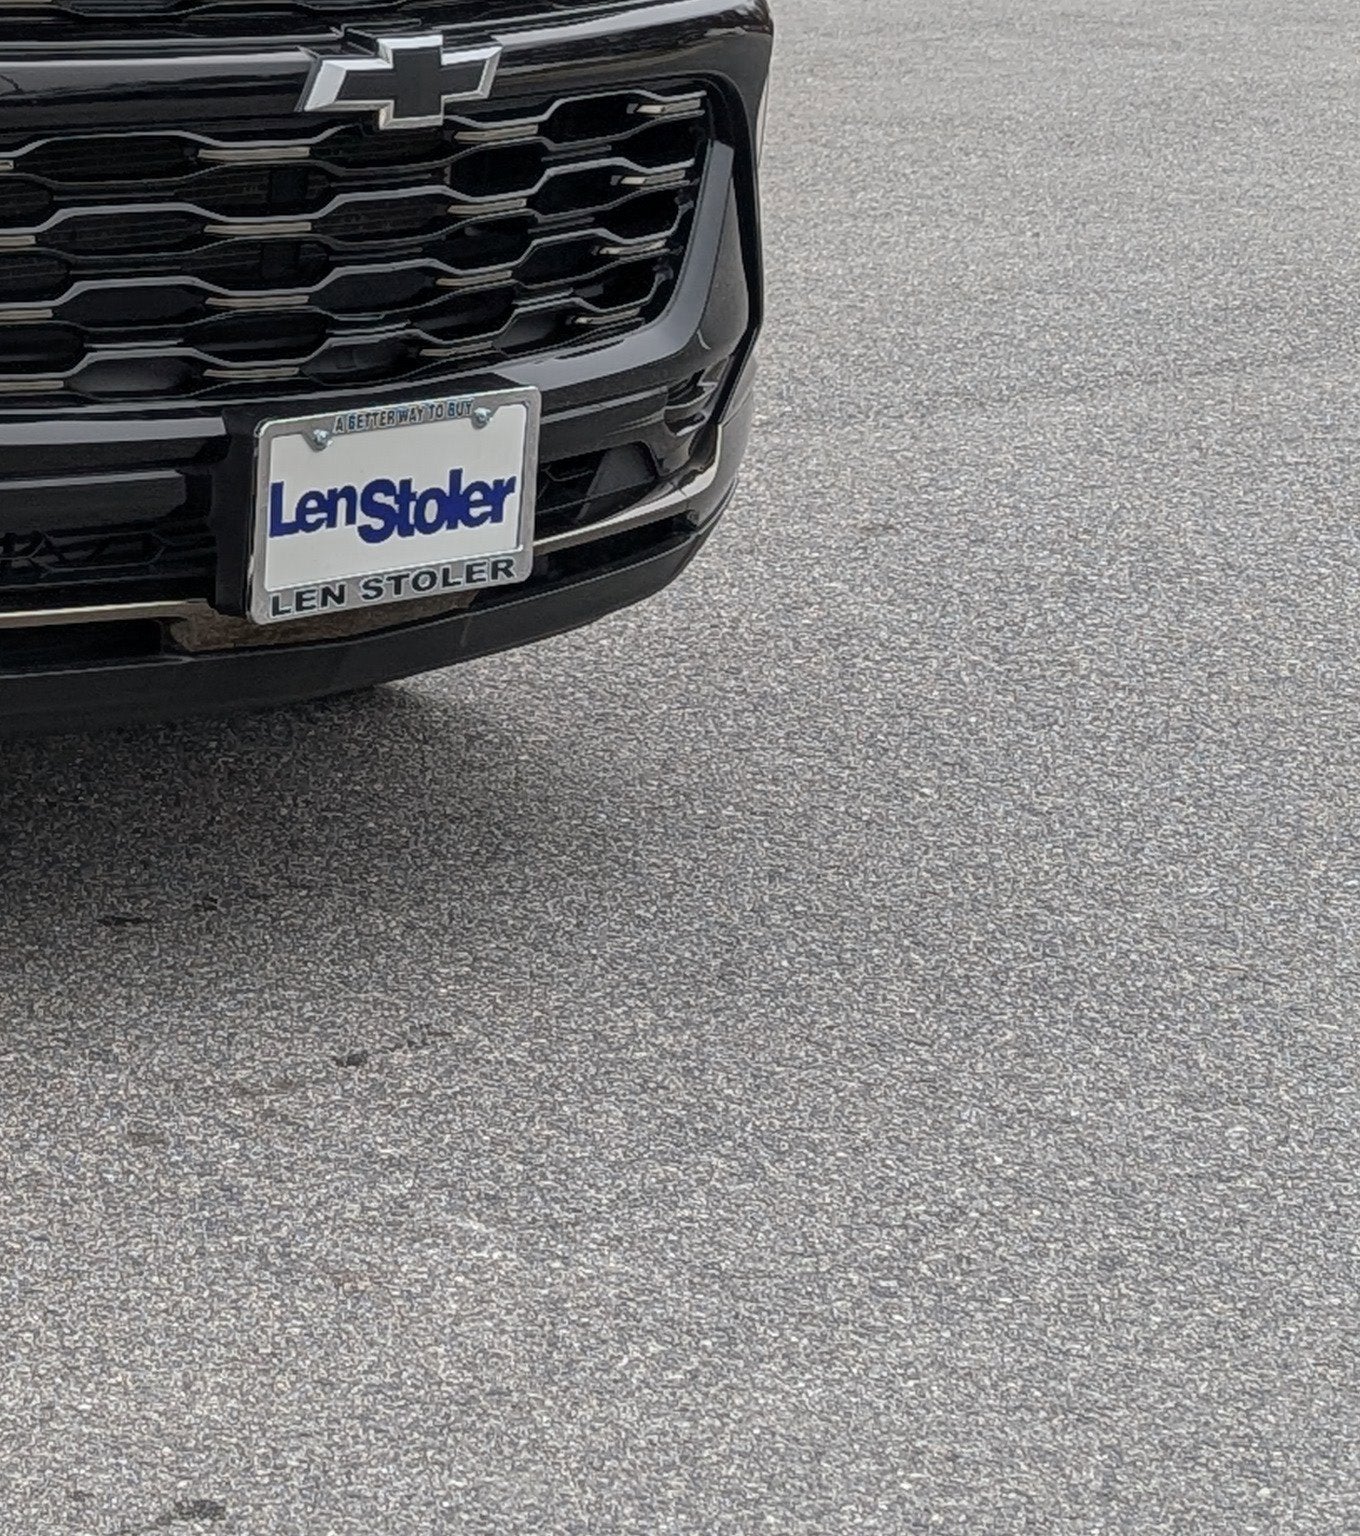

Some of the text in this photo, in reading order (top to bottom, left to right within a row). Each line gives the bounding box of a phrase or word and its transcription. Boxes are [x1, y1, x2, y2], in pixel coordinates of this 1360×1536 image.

[334, 401, 473, 432] A BETTER WAY TO BUY
[271, 558, 516, 617] LEN STOLER
